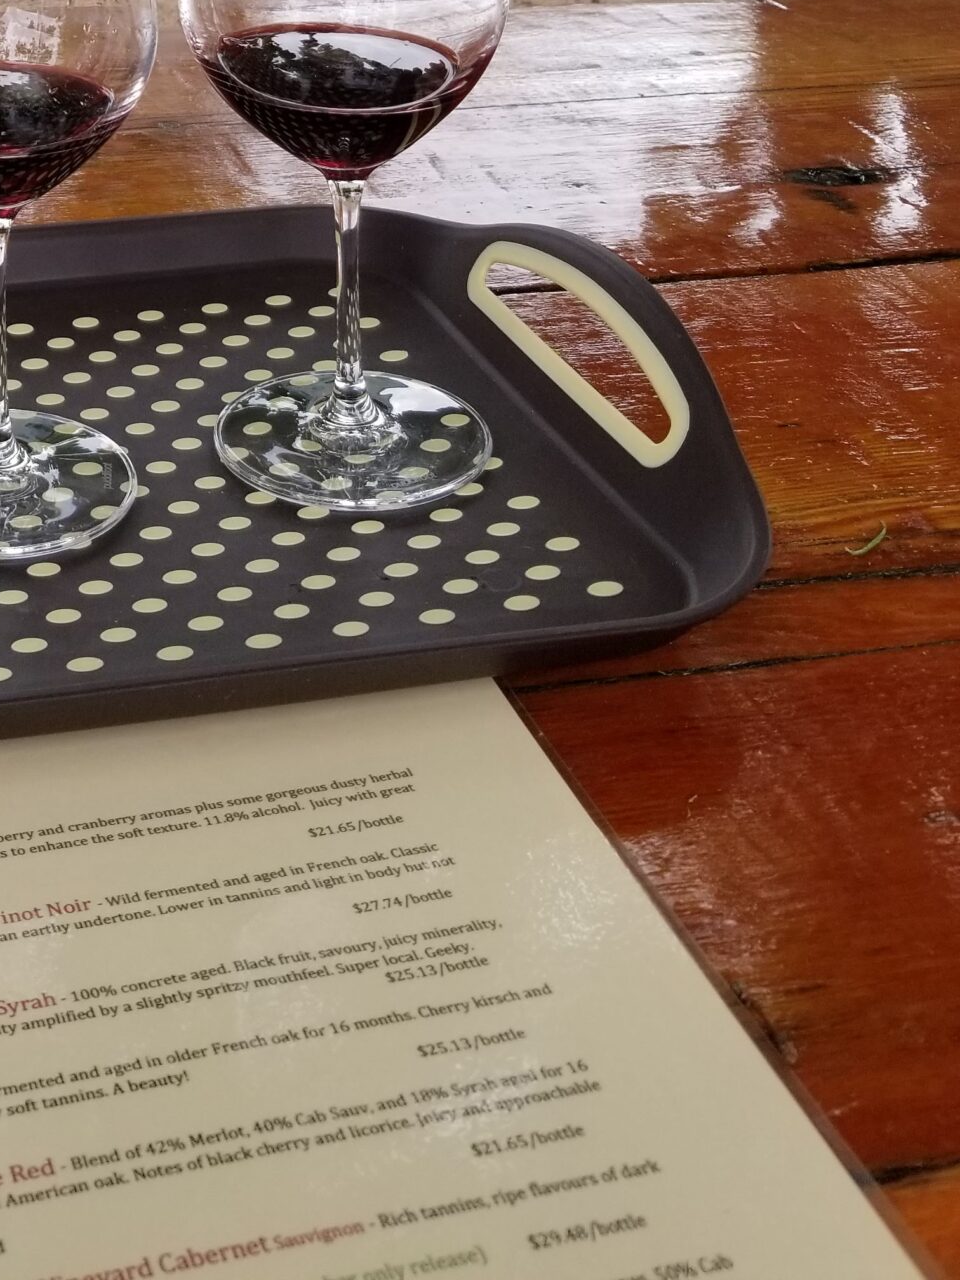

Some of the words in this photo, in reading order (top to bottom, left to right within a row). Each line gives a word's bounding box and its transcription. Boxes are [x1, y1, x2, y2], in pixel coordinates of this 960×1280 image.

[29, 838, 88, 853] enhance
[90, 833, 114, 844] the
[117, 827, 145, 840] soft
[146, 821, 202, 835] texture.
[203, 811, 250, 826] 11.8%
[251, 801, 305, 818] alcohol.
[308, 796, 342, 810] Juicy
[344, 789, 378, 802] with
[379, 784, 415, 799] great
[37, 823, 64, 836] and
[67, 815, 136, 832] cranberry
[139, 806, 192, 821] aromas
[194, 801, 224, 814] plus
[226, 794, 263, 807] some
[265, 784, 328, 802] gorgeous
[330, 777, 367, 790] dusty
[368, 767, 413, 783] herbal
[307, 814, 404, 838] $21.65/bottle
[21, 923, 70, 938] earthy
[73, 909, 156, 929] undertone.
[157, 900, 204, 915] Lower
[207, 896, 224, 906] in
[225, 887, 281, 903] tannins
[283, 879, 311, 893] and
[311, 875, 347, 889] light
[347, 872, 364, 883] in
[364, 865, 401, 879] body
[45, 899, 91, 916] Noir
[104, 891, 142, 906] Wild
[143, 878, 220, 900] fermented
[222, 873, 250, 887] and
[253, 867, 287, 883] aged
[288, 865, 305, 876] in
[306, 856, 357, 872] French
[359, 851, 389, 864] oak.
[389, 843, 439, 858] Classic
[352, 889, 452, 914] $27.74/bottle
[21, 1006, 96, 1030] amplified
[135, 990, 192, 1010] slightly
[195, 981, 249, 999] spritzy
[253, 965, 334, 988] mouthfeel.
[335, 959, 379, 974] Super
[381, 949, 424, 966] local.
[424, 942, 474, 958] Geeky.
[70, 985, 118, 1002] 100%
[120, 974, 187, 993] concrete
[190, 963, 231, 981] aged.
[232, 955, 276, 972] Black
[277, 951, 317, 965] fruit,
[318, 941, 382, 958] savoury,
[382, 933, 418, 950] juicy
[421, 919, 502, 940] minerality,
[384, 956, 488, 983] $25.13/bottle
[69, 1065, 100, 1082] and
[104, 1058, 143, 1077] aged
[145, 1056, 163, 1068] in
[166, 1048, 208, 1063] older
[210, 1035, 268, 1055] French
[270, 1029, 301, 1044] oak
[301, 1026, 325, 1039] for
[329, 1020, 351, 1034] 16
[353, 1011, 416, 1030] months.
[417, 1001, 470, 1018] Cherry
[471, 990, 521, 1008] kirsch
[522, 983, 553, 999] and
[416, 1028, 525, 1057] $25.13/bottle
[6, 1099, 38, 1116] soft
[127, 1070, 189, 1092] beauty!
[9, 1157, 56, 1183] Red
[70, 1149, 121, 1170] Blend
[145, 1137, 186, 1155] 42%
[253, 1116, 293, 1133] 40%
[294, 1109, 327, 1126] Cab
[376, 1093, 407, 1111] and
[539, 1066, 563, 1079] for
[566, 1059, 589, 1074] 16
[5, 1181, 89, 1207] American
[132, 1163, 183, 1181] Notes
[205, 1146, 253, 1166] black
[255, 1137, 310, 1156] cherry
[315, 1127, 347, 1145] and
[470, 1125, 584, 1157] $21.65/bottle
